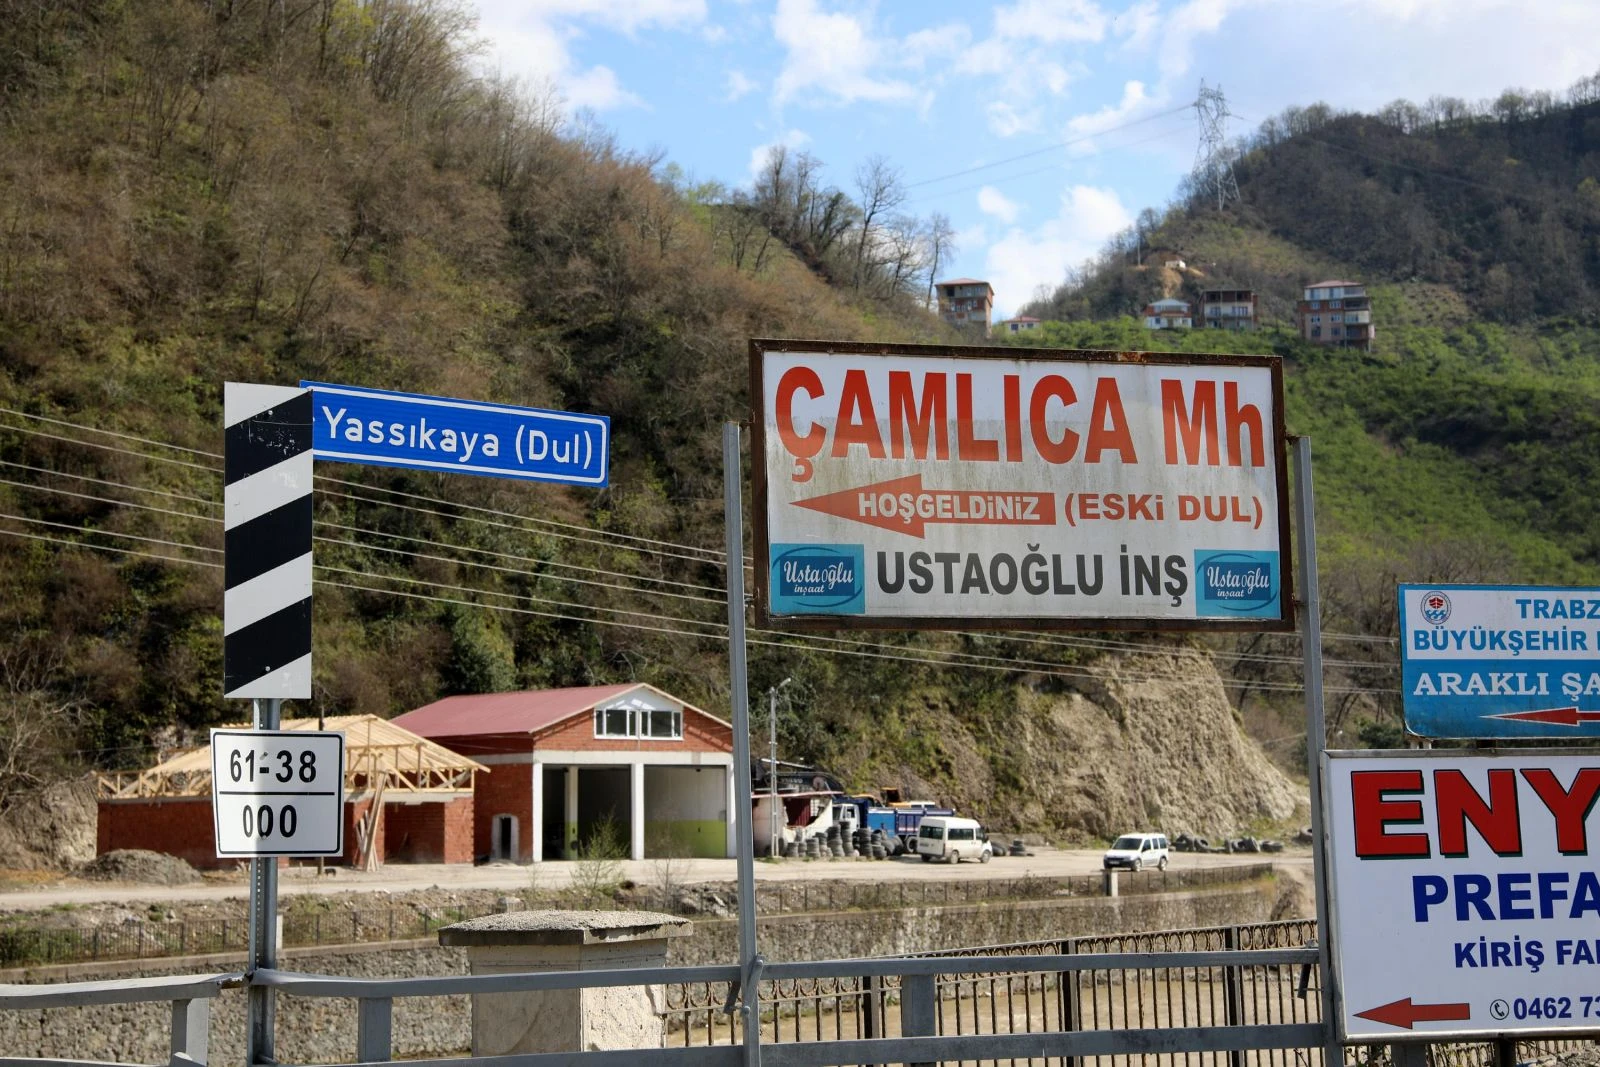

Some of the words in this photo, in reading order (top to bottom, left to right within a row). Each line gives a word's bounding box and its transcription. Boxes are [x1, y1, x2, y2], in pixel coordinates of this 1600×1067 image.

[322, 406, 499, 462] Yassıkaya
[515, 425, 592, 469] (Dul)
[775, 366, 1137, 482] ÇAMLICA
[1161, 379, 1265, 467] Mh
[1178, 496, 1263, 530] DUL)
[783, 560, 854, 590] Ustaoğlu
[794, 584, 825, 595] inşaat
[876, 543, 1104, 596] USTAOĞLU
[1119, 544, 1189, 608] İNŞ
[1207, 566, 1270, 595] Ustaoğlu
[1217, 588, 1245, 599] inşaat
[1516, 599, 1600, 620] TRABZ
[1414, 626, 1588, 656] BÜYÜKŞEHİR
[1413, 673, 1549, 696] ARAKLI
[1562, 673, 1600, 702] ŞA
[230, 749, 317, 783] 61-38
[242, 804, 297, 838] 000
[1351, 768, 1600, 860] ENY
[1412, 872, 1600, 922] PREFA
[1454, 935, 1545, 973] KİRİŞ
[1556, 939, 1600, 966] FA
[1513, 997, 1572, 1020] 0462
